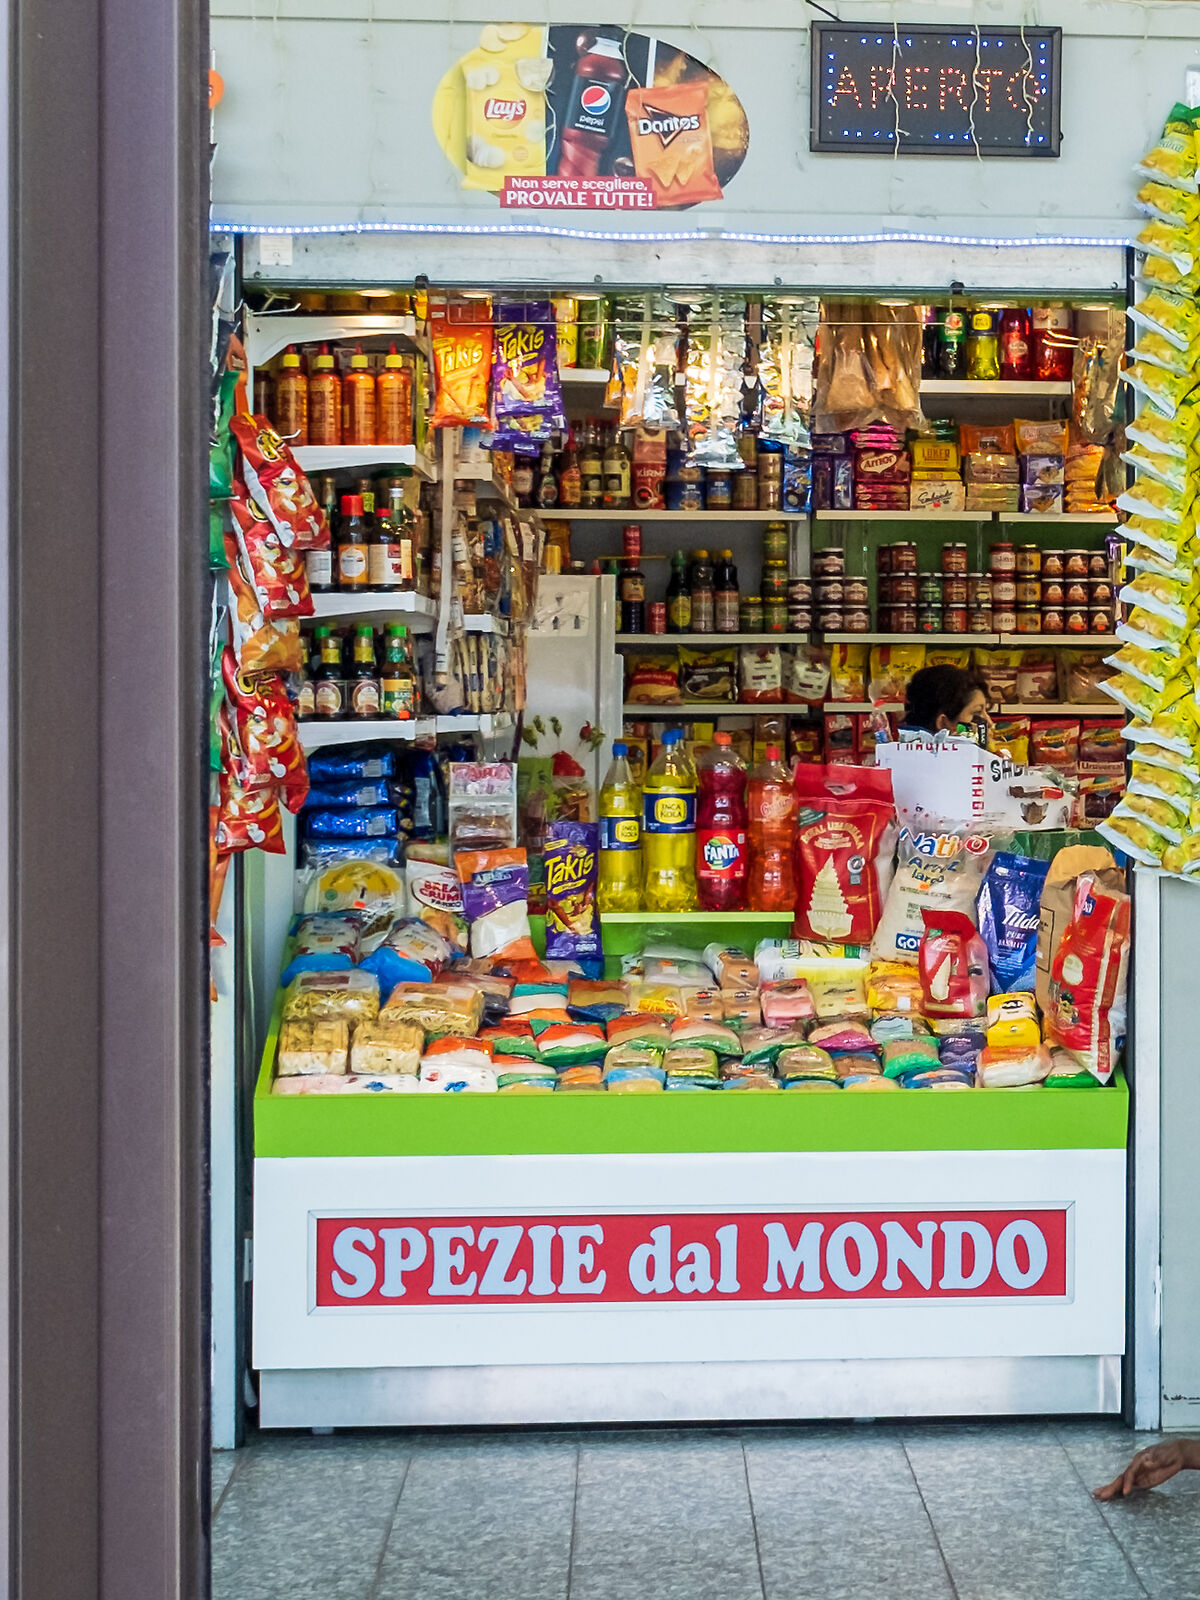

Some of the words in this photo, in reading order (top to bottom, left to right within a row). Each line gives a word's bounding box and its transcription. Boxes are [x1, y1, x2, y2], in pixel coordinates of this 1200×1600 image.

[831, 65, 1041, 112] APERTO
[487, 99, 526, 120] Lay's
[579, 115, 604, 127] pepsi
[638, 114, 700, 136] Doritos
[511, 177, 538, 189] Non
[542, 179, 579, 190] serve
[582, 177, 648, 192] scegliere,
[506, 190, 587, 206] PROVALE
[591, 191, 653, 207] TUTTE!
[499, 330, 544, 360] Takis
[436, 344, 483, 377] Takis
[863, 456, 894, 473] Amor
[971, 764, 985, 818] FRAGI
[704, 844, 740, 861] FANTA
[900, 826, 992, 858] Nativo
[545, 852, 595, 890] Takis
[419, 888, 462, 901] CRUM
[424, 881, 460, 893] BREA
[1002, 905, 1040, 930] Tilda
[898, 936, 920, 950] GO
[1007, 930, 1025, 940] PURE
[331, 1222, 606, 1299] SPEZIE
[628, 1223, 741, 1295] dal
[762, 1217, 1050, 1294] MONDO
